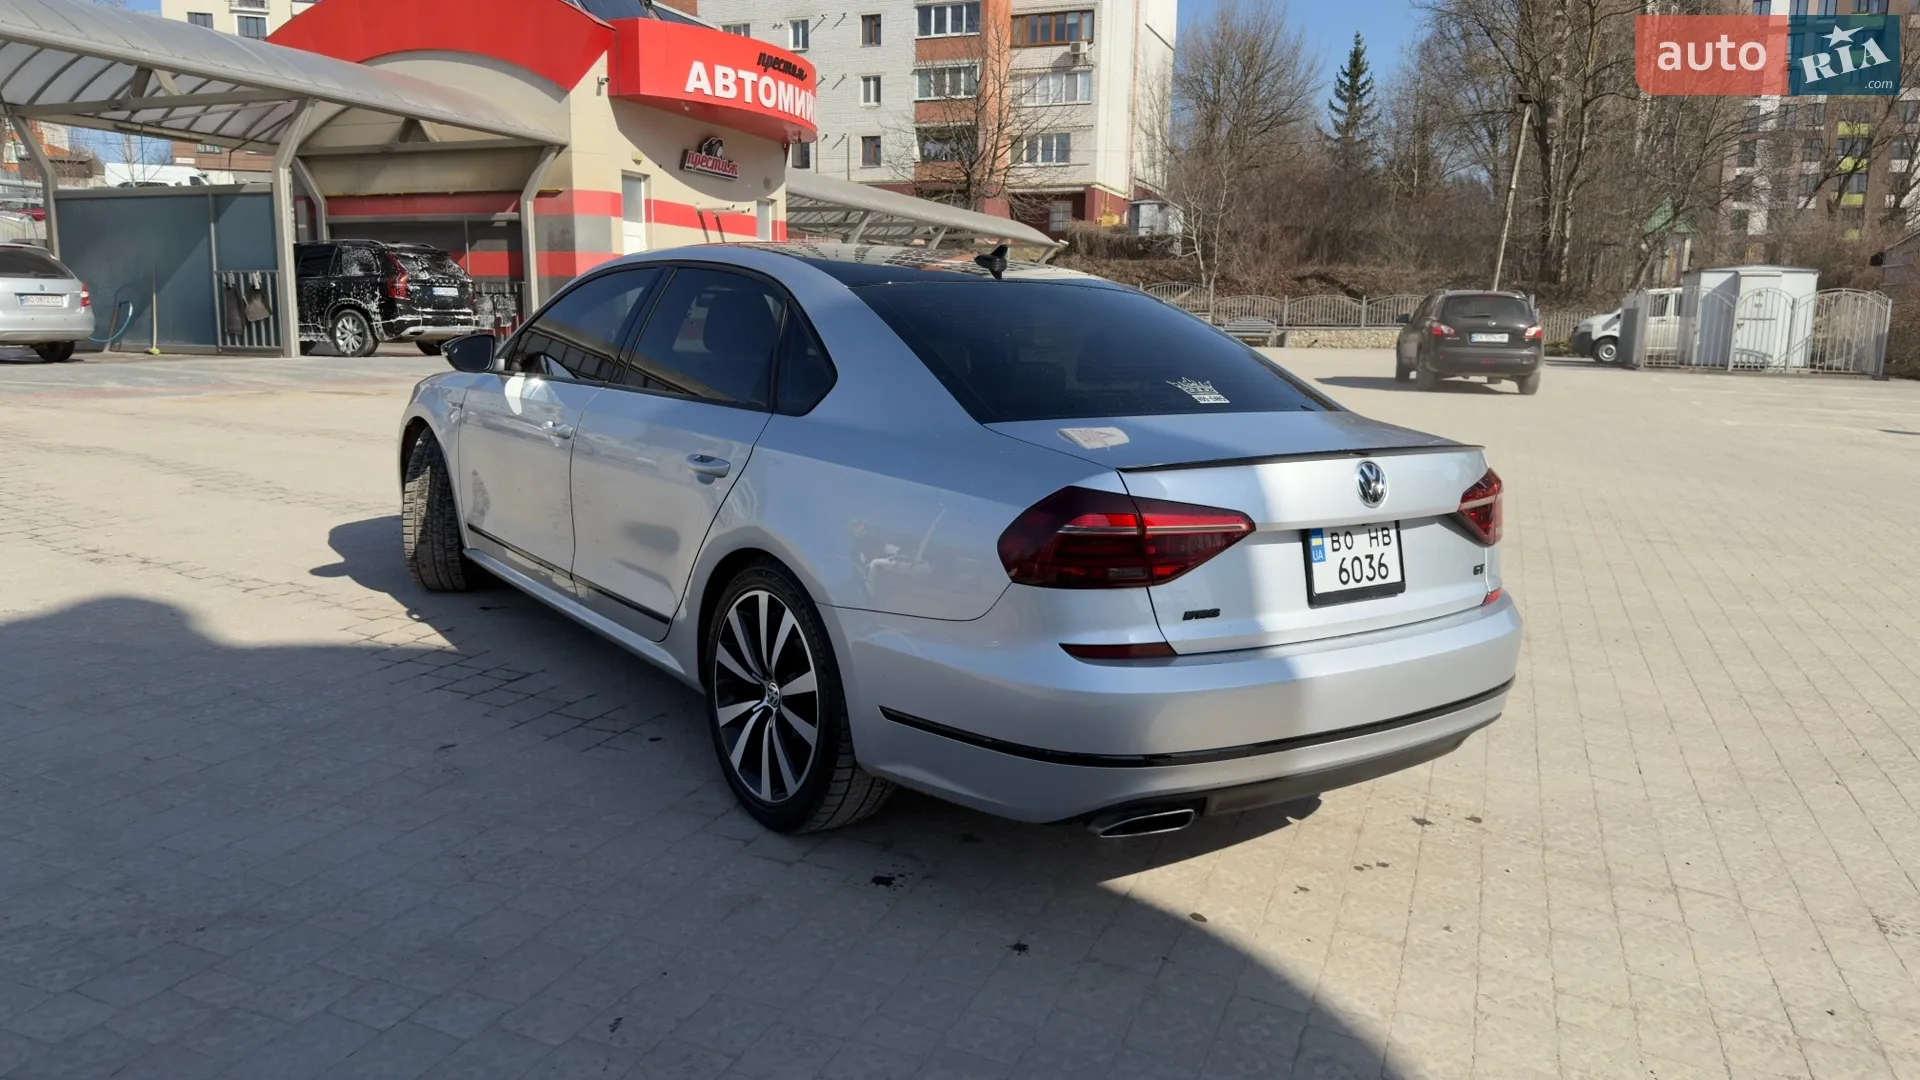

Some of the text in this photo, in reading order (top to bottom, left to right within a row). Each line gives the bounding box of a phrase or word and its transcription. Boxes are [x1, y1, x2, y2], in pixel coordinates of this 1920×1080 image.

[1330, 526, 1391, 552] BO HB
[1312, 550, 1324, 560] UA
[1338, 552, 1389, 585] 6036
